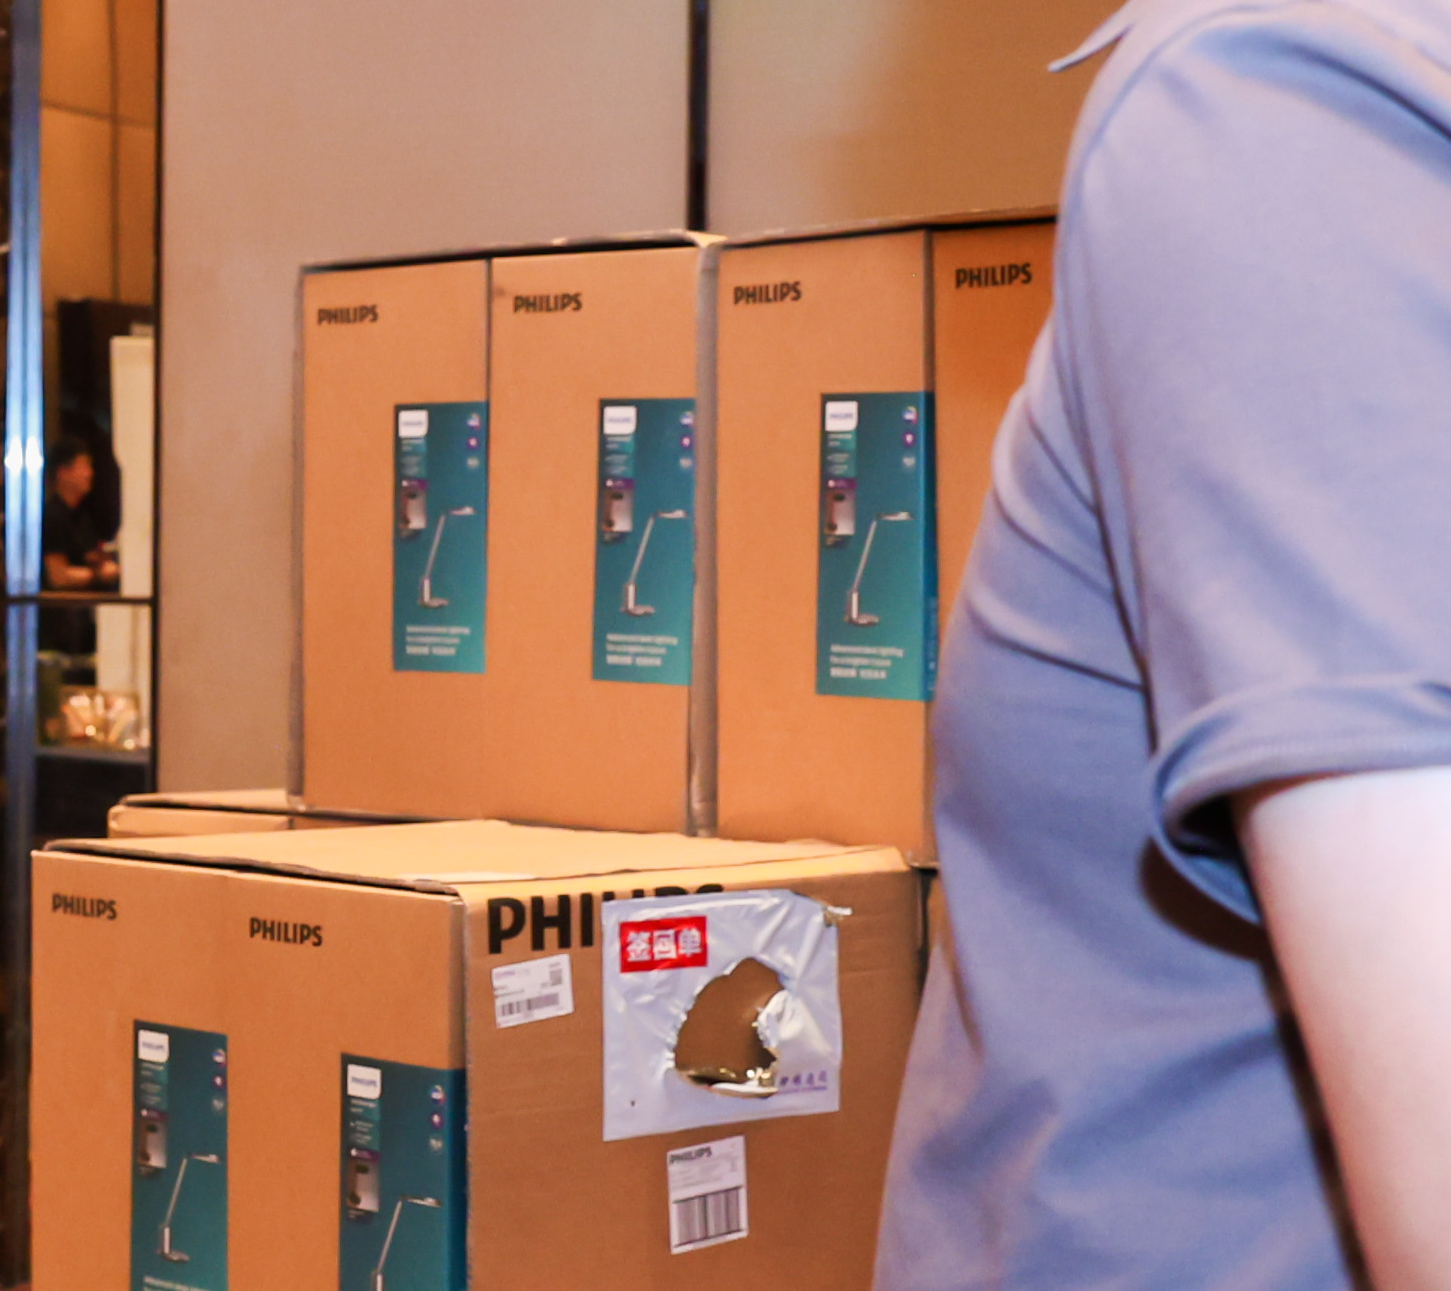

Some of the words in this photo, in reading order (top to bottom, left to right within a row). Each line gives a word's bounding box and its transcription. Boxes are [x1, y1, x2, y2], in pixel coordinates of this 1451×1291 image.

[955, 262, 1033, 289] PHILIPS
[513, 291, 584, 315] PHILIPS
[733, 281, 802, 306] PHILIPS
[316, 304, 379, 326] PHILIPS
[52, 892, 118, 921] PHILIPS
[249, 916, 324, 947] PHILIPS
[626, 928, 703, 963] 签回单
